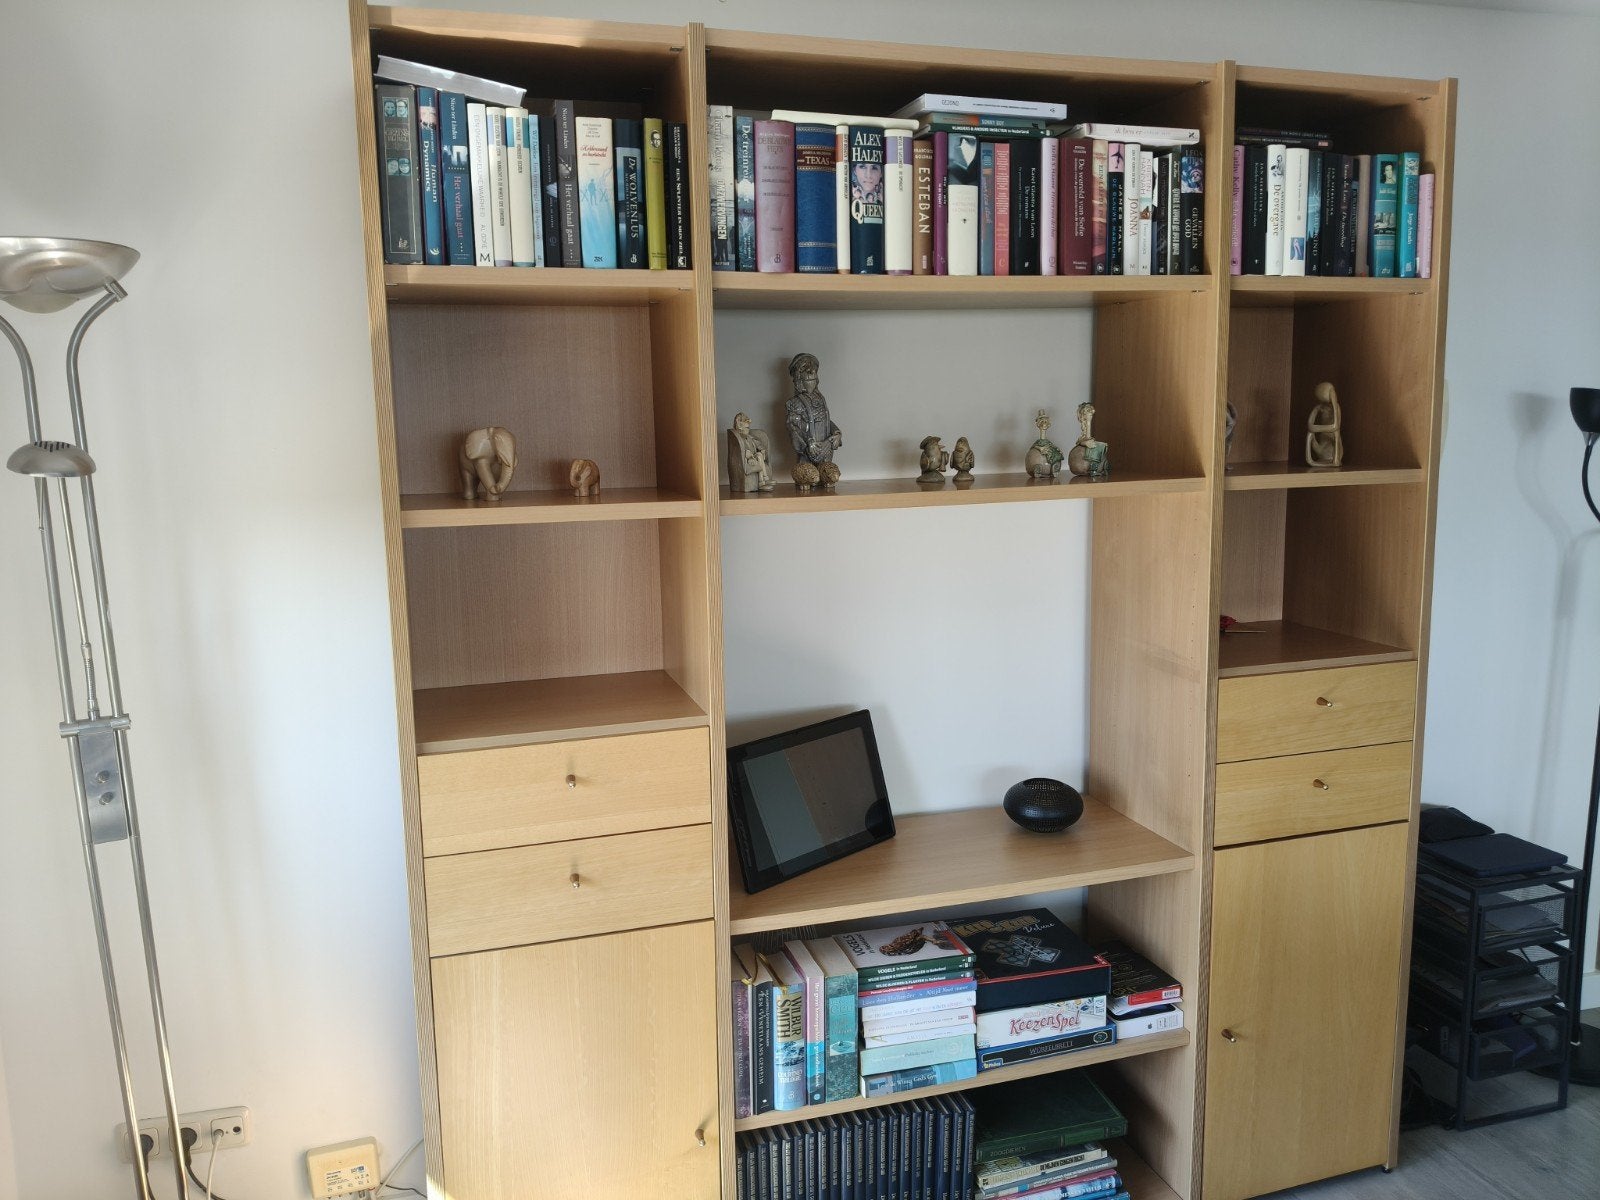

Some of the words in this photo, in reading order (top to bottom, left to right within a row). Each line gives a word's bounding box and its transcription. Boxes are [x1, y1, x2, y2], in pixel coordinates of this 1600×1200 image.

[742, 125, 751, 139] De
[854, 131, 881, 146] ALEX
[423, 140, 432, 192] Dynamics
[805, 156, 830, 165] TEXAS
[852, 147, 884, 162] HALEY
[1078, 158, 1085, 170] De
[1232, 149, 1240, 173] Cathy
[1232, 176, 1240, 197] Kelly
[1273, 184, 1281, 196] De
[629, 172, 639, 238] WOLVENLUS
[716, 179, 727, 240] OMZWERVINGEN
[851, 199, 883, 224] QUEEN
[918, 167, 930, 233] ESTEBAN
[1128, 197, 1138, 237] JOANNA
[1270, 197, 1281, 236] overgave
[565, 229, 574, 244] gaat
[777, 997, 792, 1038] SMITH
[790, 996, 803, 1037] WILBUR
[758, 1009, 766, 1056] VENETIAANS
